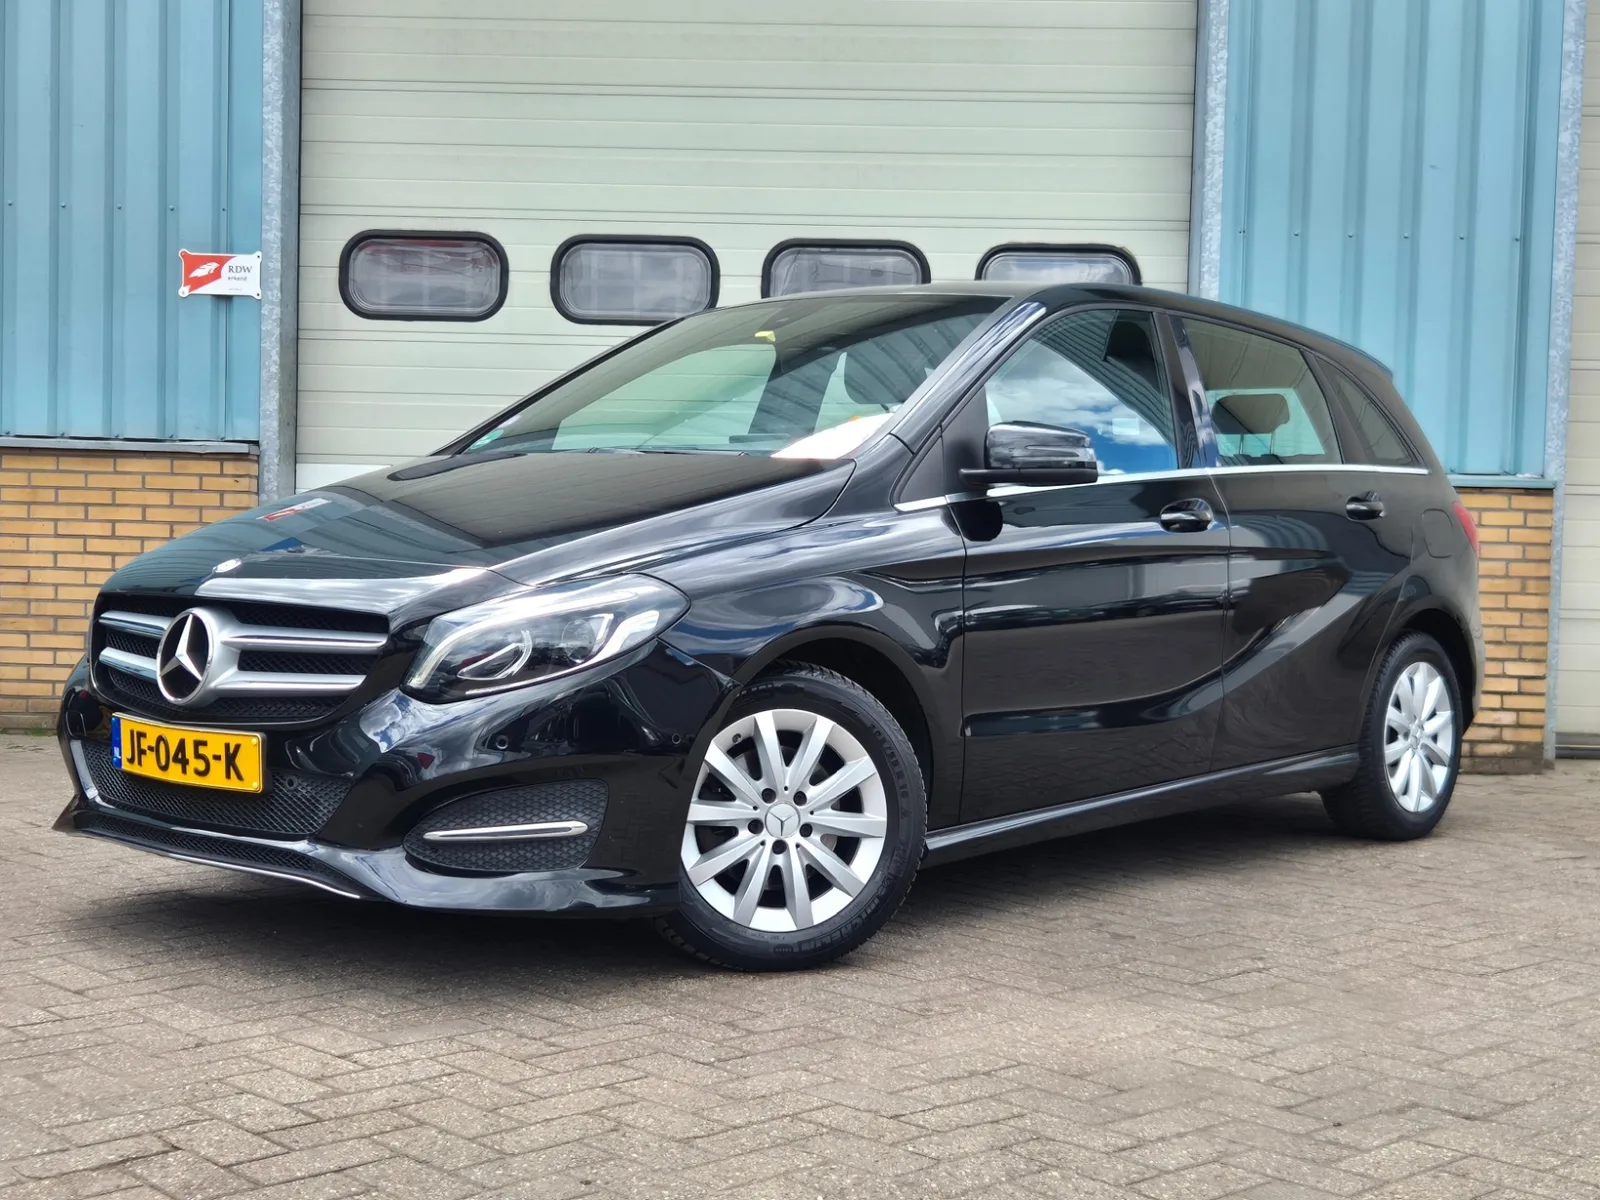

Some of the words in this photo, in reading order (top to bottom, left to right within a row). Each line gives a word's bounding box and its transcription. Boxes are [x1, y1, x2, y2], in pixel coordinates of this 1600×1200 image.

[228, 265, 253, 274] RDW
[126, 729, 244, 781] JF-045-K
[799, 896, 881, 954] MICHELIN
